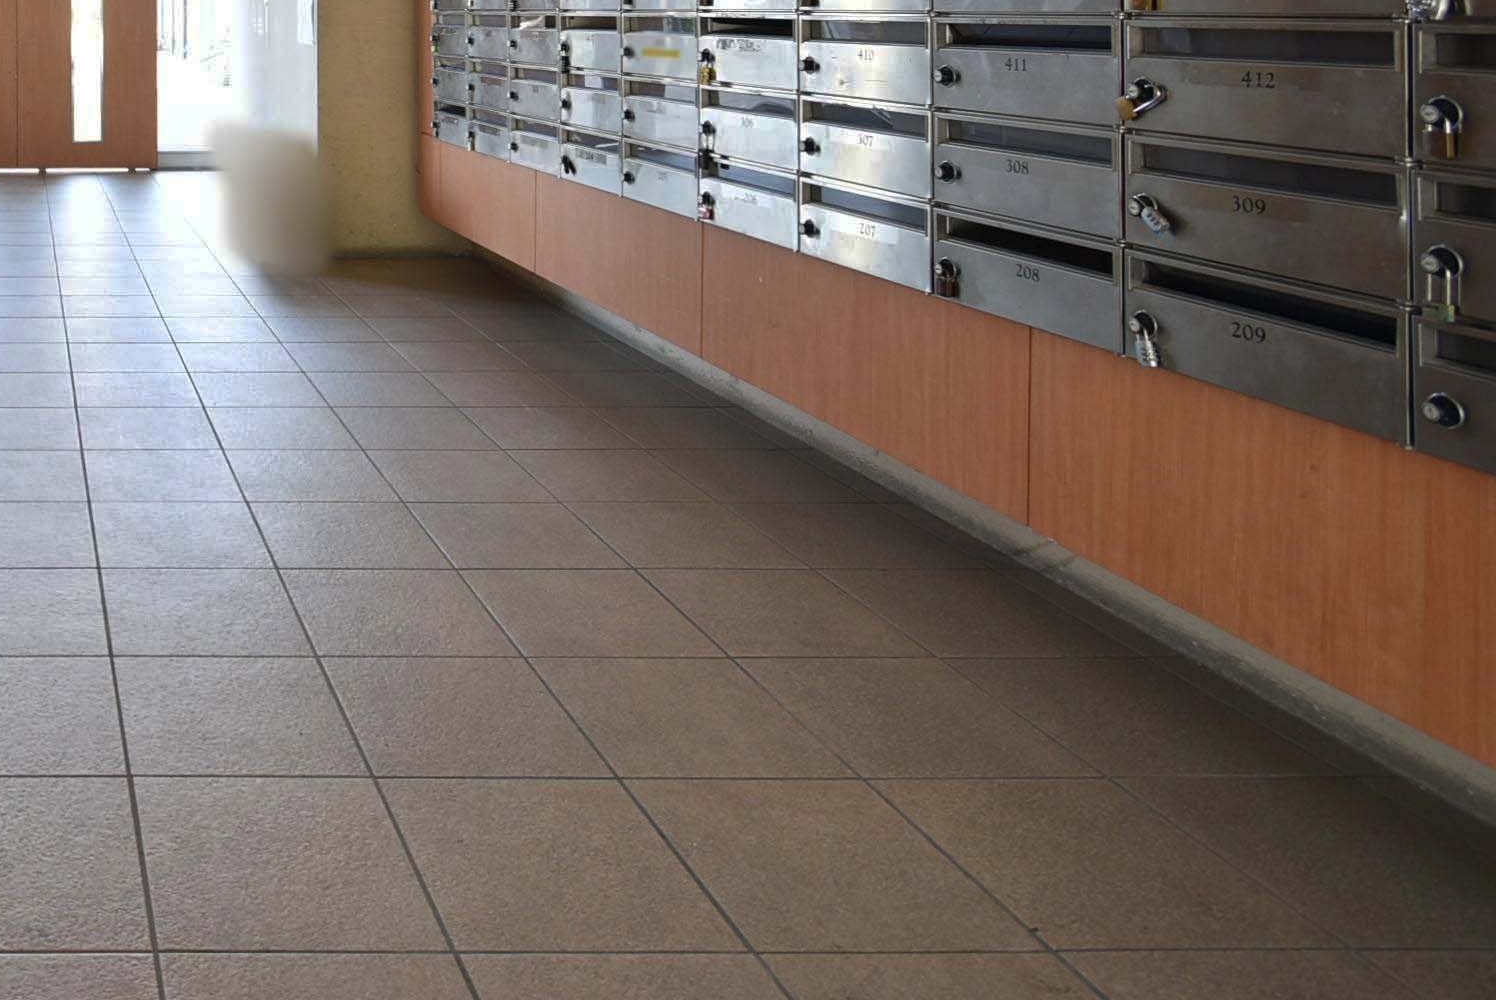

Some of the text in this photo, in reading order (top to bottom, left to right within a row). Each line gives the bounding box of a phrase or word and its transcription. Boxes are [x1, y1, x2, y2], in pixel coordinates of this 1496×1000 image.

[857, 49, 875, 62] 410
[1005, 58, 1028, 73] 411
[1241, 70, 1276, 89] 412
[1005, 159, 1029, 176] 308
[1232, 195, 1266, 216] 309
[859, 222, 877, 239] 207
[1016, 263, 1041, 282] 208
[1231, 322, 1266, 344] 209
